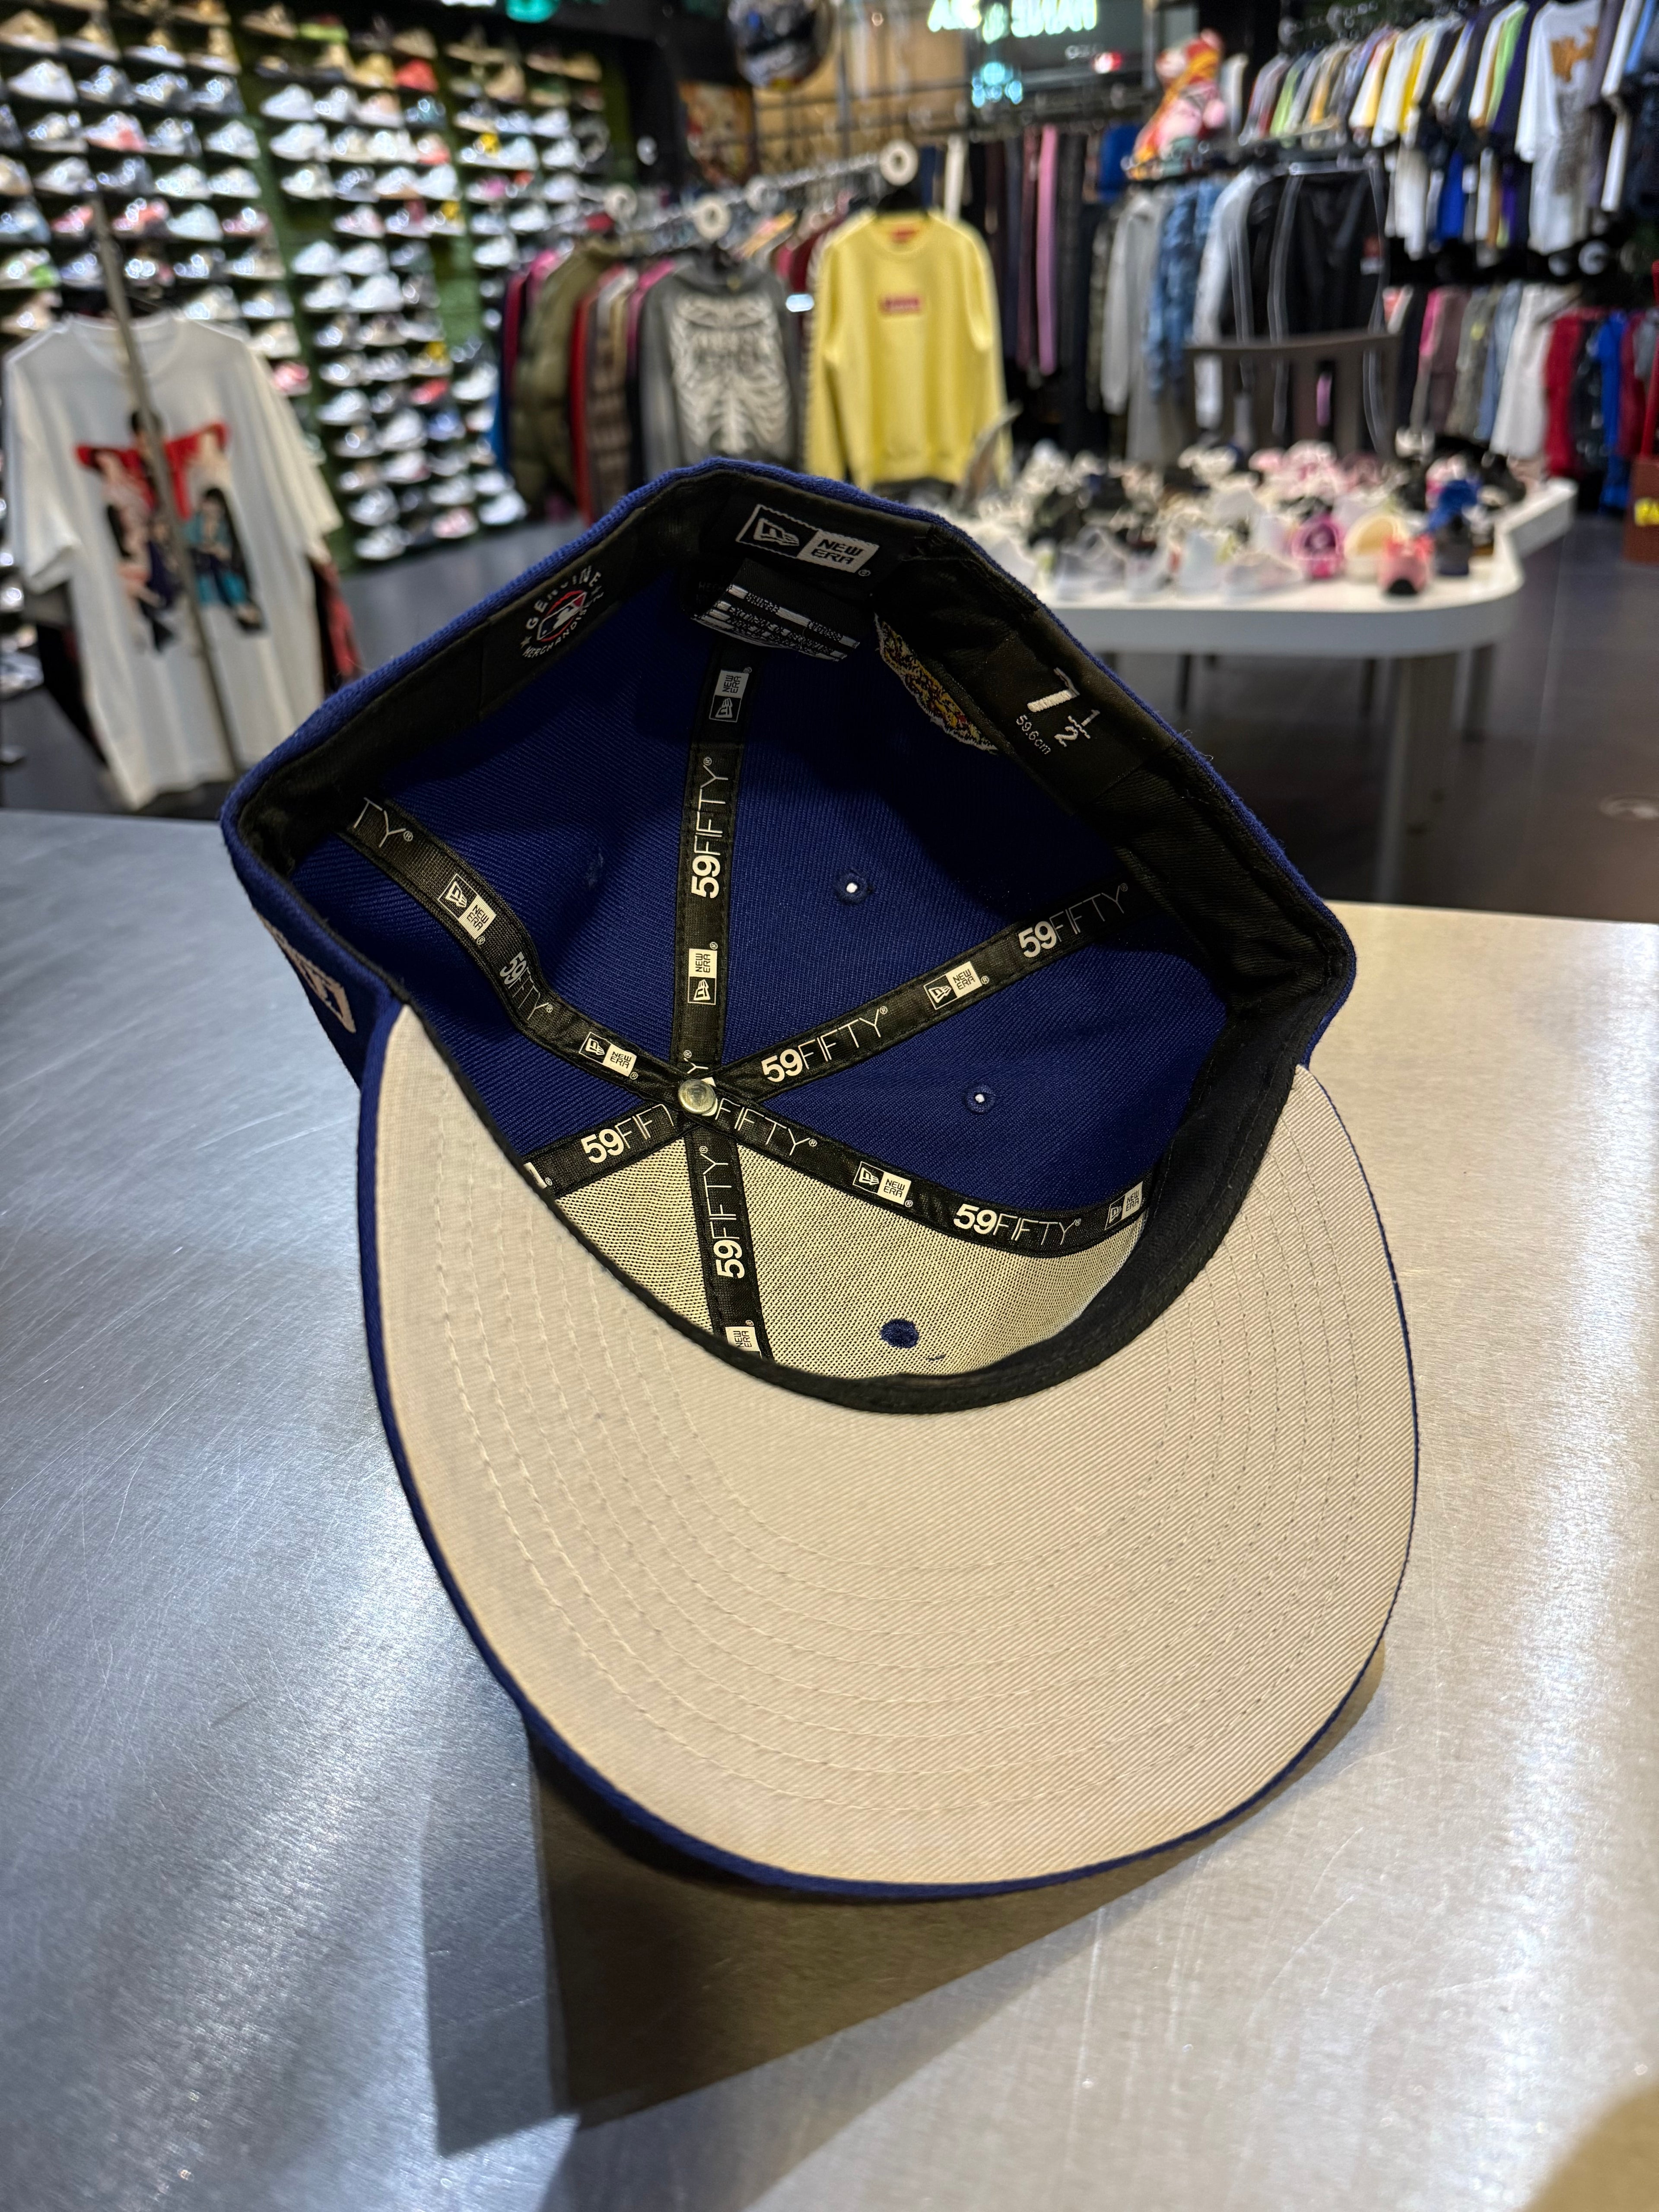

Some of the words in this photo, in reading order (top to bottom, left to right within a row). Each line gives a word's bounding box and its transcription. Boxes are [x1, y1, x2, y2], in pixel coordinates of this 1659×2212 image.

[817, 539, 864, 556] NEW
[811, 549, 855, 564] ERA
[526, 566, 601, 629] GENUINE
[722, 675, 734, 693] NEW
[730, 676, 741, 693] ERA
[1027, 667, 1080, 712] 7
[1016, 715, 1051, 754] 59.6cm
[467, 912, 483, 931] ERA
[472, 905, 489, 924] NEW
[695, 953, 703, 973] NEW
[953, 969, 972, 983] NEW
[957, 976, 976, 990] ERA
[610, 1056, 629, 1068] ERA
[611, 1051, 632, 1062] NEW
[884, 1185, 903, 1198] ERA
[886, 1179, 906, 1191] NEW
[1126, 1198, 1139, 1212] ERA
[1127, 1190, 1139, 1204] NEW
[741, 1331, 752, 1348] ERA
